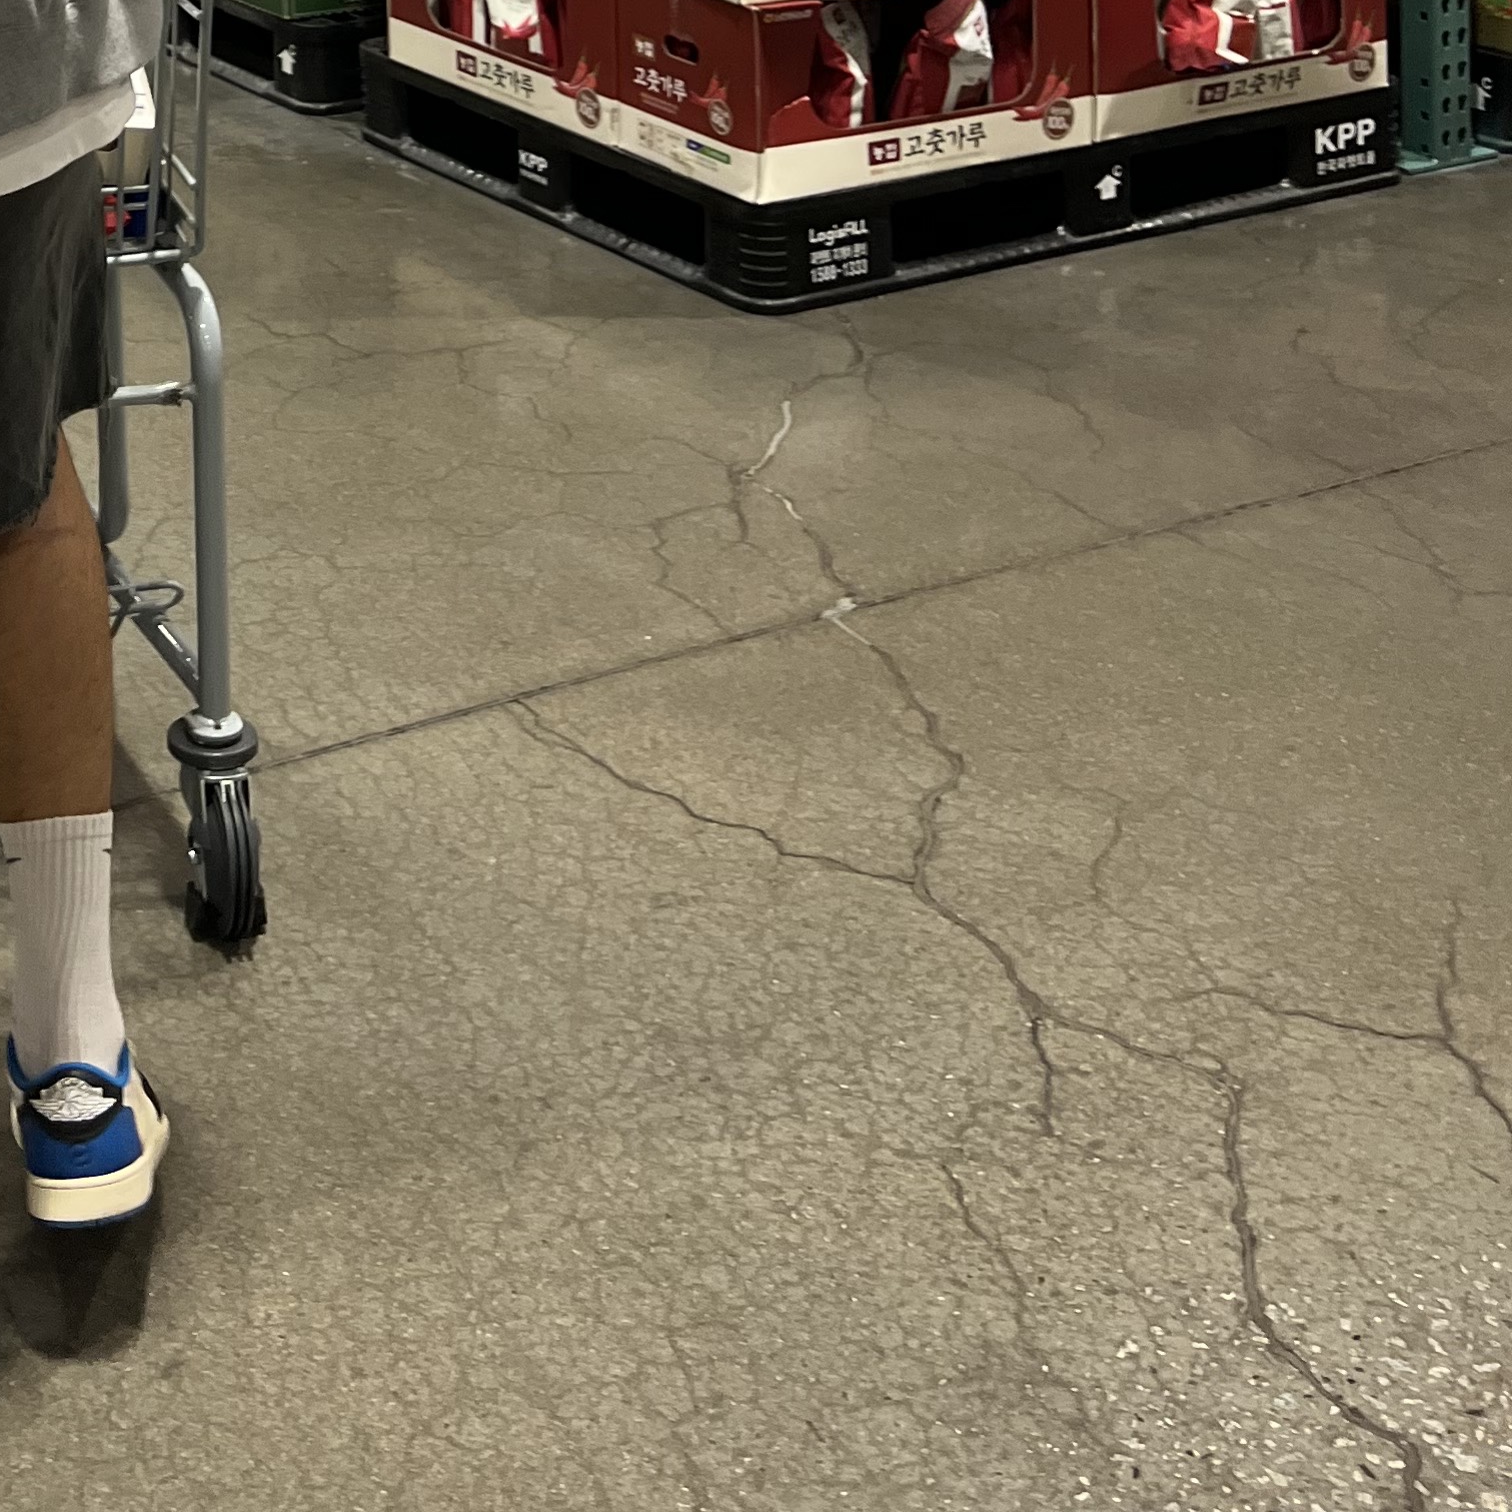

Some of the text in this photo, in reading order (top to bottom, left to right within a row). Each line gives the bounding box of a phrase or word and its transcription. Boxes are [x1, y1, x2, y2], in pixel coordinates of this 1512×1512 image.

[479, 58, 534, 97] 고춧가루
[632, 67, 687, 102] 고춧가루
[1229, 68, 1301, 98] 고춧가루
[904, 122, 987, 159] 고춧가루
[1315, 118, 1376, 155] KPP
